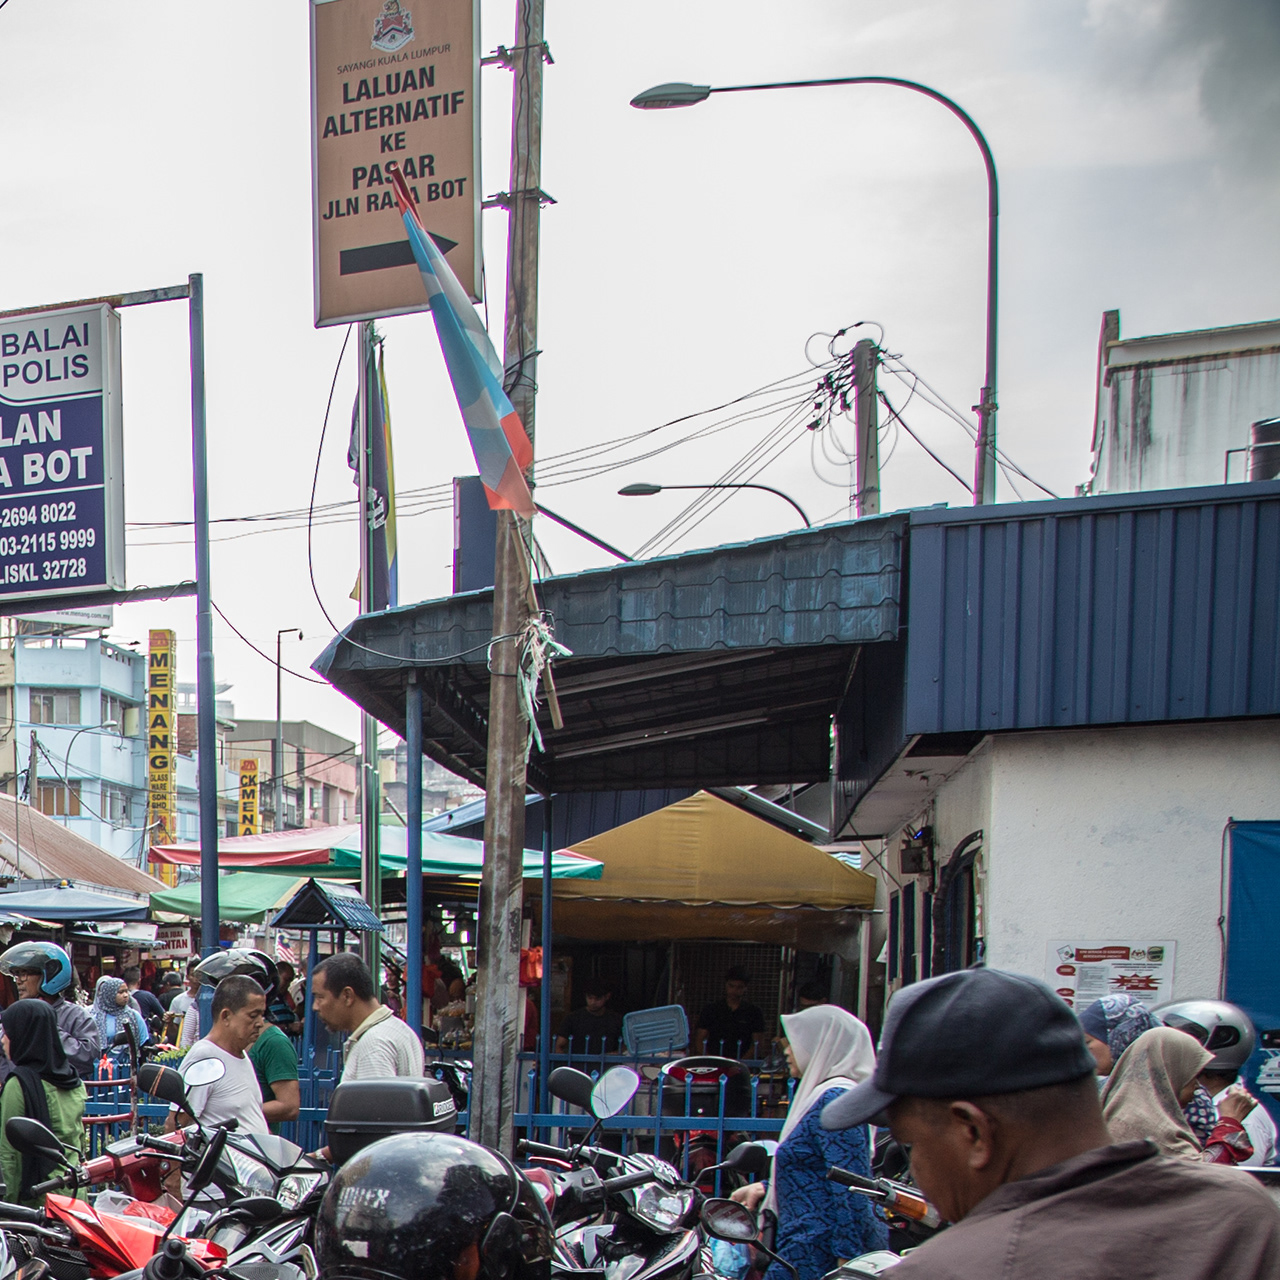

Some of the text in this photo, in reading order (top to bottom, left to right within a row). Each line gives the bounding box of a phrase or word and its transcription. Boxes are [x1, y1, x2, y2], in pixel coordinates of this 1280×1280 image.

[337, 43, 451, 75] SAYANGI KUALA LUMPUR
[343, 65, 435, 104] LALUAN
[322, 90, 465, 139] ALTERNATIF
[380, 131, 406, 153] KE
[352, 154, 435, 190] PASAR
[323, 177, 467, 220] JLN RAA BOT
[1, 323, 89, 357] BALAI
[3, 354, 89, 387] POLIS
[23, 446, 93, 486] BOT
[41, 501, 77, 524] 8022
[0, 532, 56, 557] 03-2115
[60, 527, 96, 551] 9999
[42, 557, 87, 581] 32728
[56, 611, 110, 621] www.menang.com.my
[150, 653, 169, 770] MENANG
[150, 774, 168, 782] GLASS
[240, 774, 256, 786] CK
[170, 930, 184, 938] JUAL
